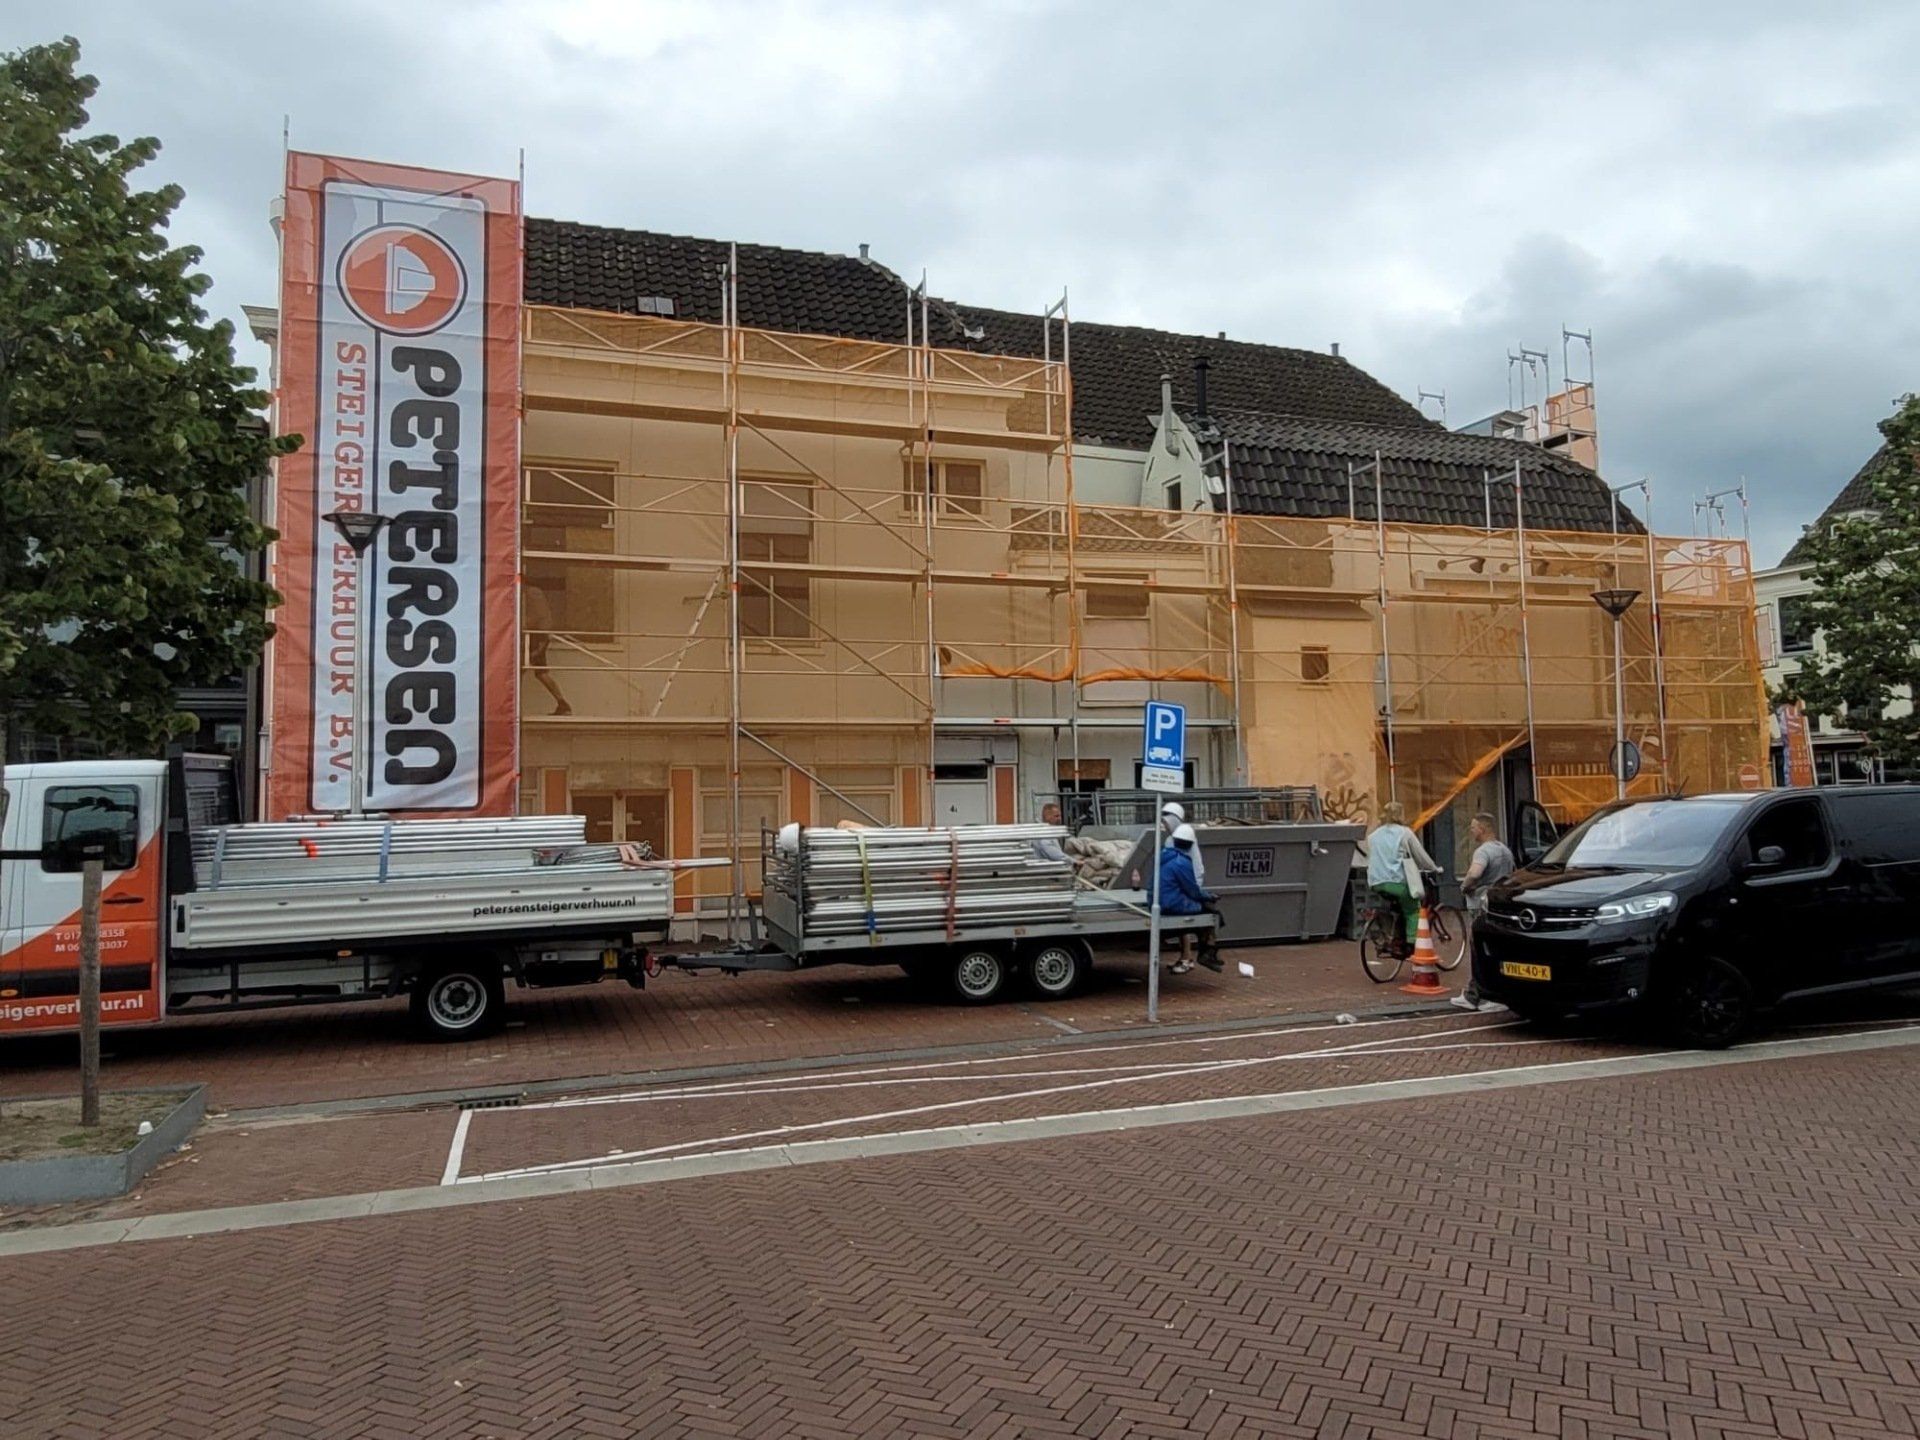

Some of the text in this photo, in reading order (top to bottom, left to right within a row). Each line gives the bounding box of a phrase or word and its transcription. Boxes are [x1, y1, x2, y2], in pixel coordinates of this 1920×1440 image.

[329, 341, 367, 696] STEIGERERHUUR
[384, 345, 463, 785] PETERSEN
[1154, 707, 1177, 740] P
[1230, 860, 1270, 873] HELM
[1232, 851, 1270, 860] VAN DER
[473, 896, 636, 917] petersensteigerverhuur.nl
